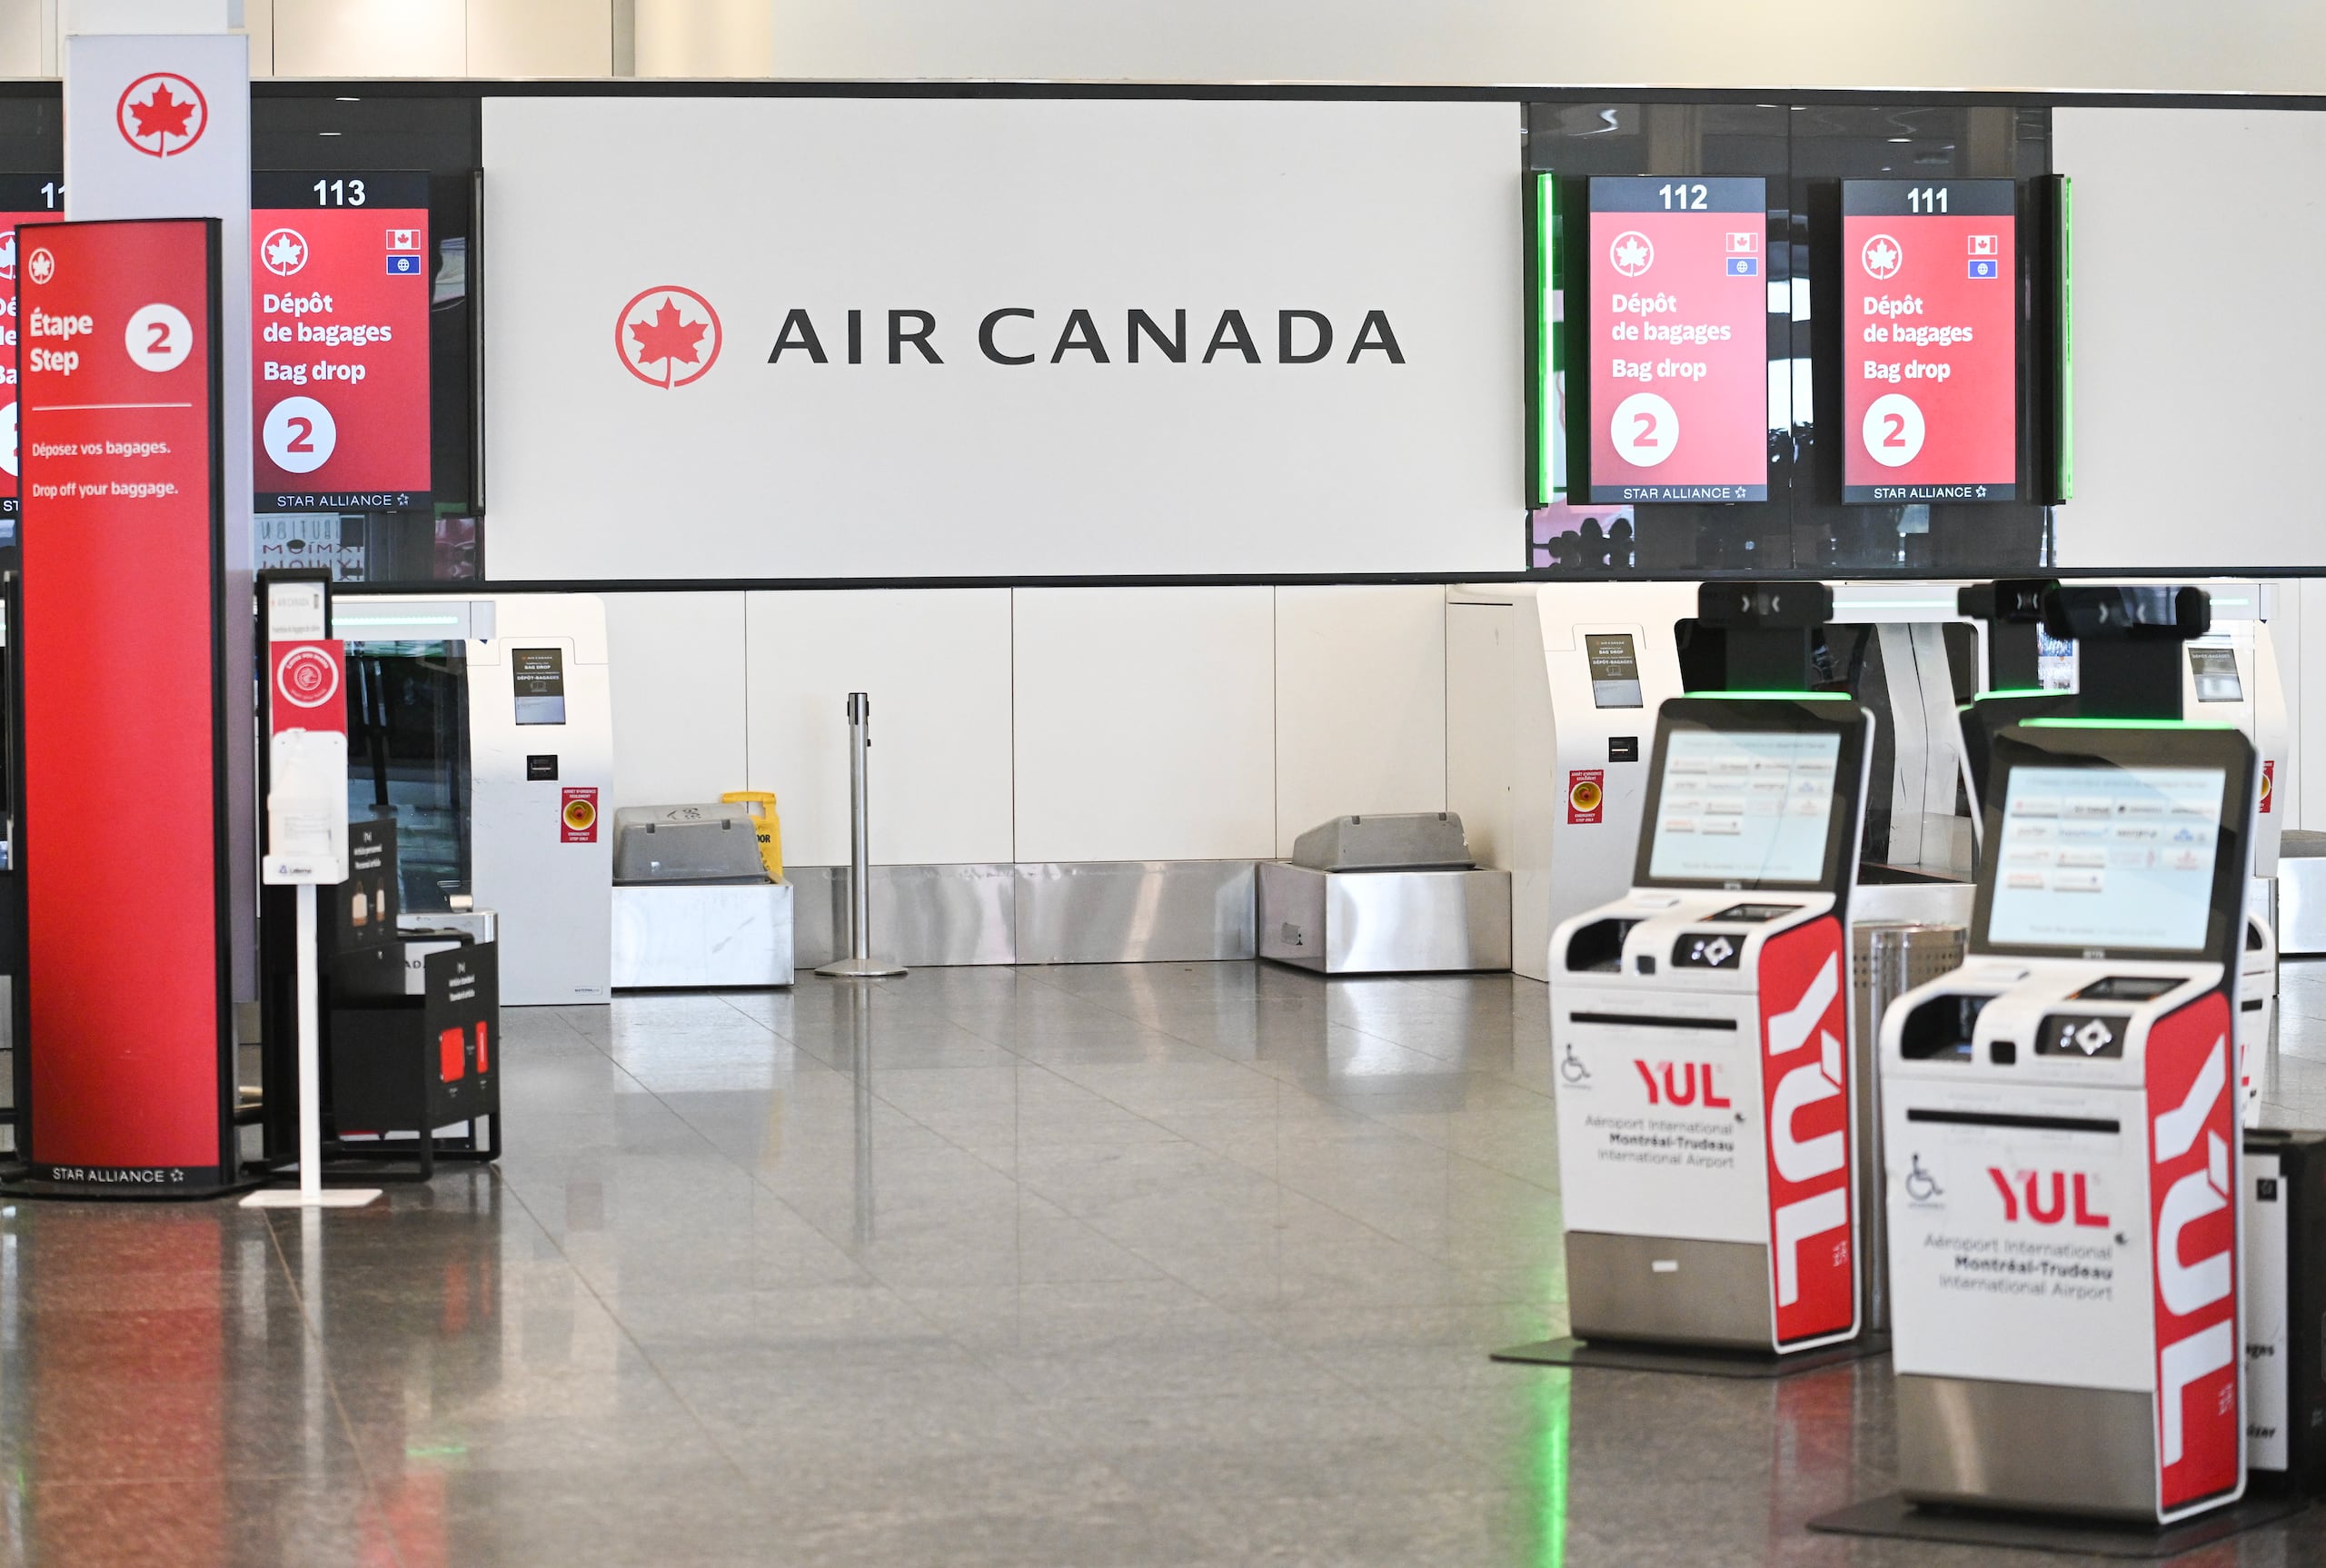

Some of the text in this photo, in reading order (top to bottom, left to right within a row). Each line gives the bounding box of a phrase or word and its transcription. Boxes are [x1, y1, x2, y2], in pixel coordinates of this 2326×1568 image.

[313, 179, 366, 206] 113
[1659, 184, 1708, 210] 112
[1907, 187, 1948, 213] 111
[263, 291, 333, 318] Dépôt
[1612, 292, 1677, 317] Dépôt
[1864, 293, 1923, 318] Dépôt
[30, 306, 94, 342] Étape
[263, 322, 393, 347] de bagages
[767, 307, 1407, 366] AIR CANADA
[1611, 321, 1732, 345] de bagages
[1863, 323, 1973, 347] de bagages
[146, 322, 172, 354] 2
[30, 347, 79, 376] Step
[263, 360, 366, 385] Bag drop
[1612, 358, 1707, 382] Bag drop
[1864, 359, 1951, 383] Bag drop
[286, 416, 314, 453] 2
[1633, 412, 1658, 447] 2
[1883, 412, 1906, 448] 2
[32, 441, 172, 460] Déposez vos bagages.
[32, 481, 179, 500] Drop off your baggage.
[277, 494, 393, 507] STAR ALLIANCE
[1623, 487, 1731, 500] STAR ALLIANCE
[1874, 486, 1973, 499] STAR ALLIANCE
[1633, 1059, 1731, 1108] YUL
[1585, 1116, 1733, 1135] Aéroport International
[1768, 949, 1847, 1308] YUL
[1610, 1133, 1734, 1152] Montréal-Trudeau
[1598, 1149, 1735, 1169] International Airport
[53, 1166, 164, 1183] STAR ALLIANCE
[1987, 1167, 2110, 1229] YUL
[1923, 1235, 2112, 1259] Aéroport International
[2154, 1032, 2234, 1468] YUL
[1955, 1256, 2113, 1280] Montréal-Trudeau
[1940, 1275, 2112, 1302] International Airport
